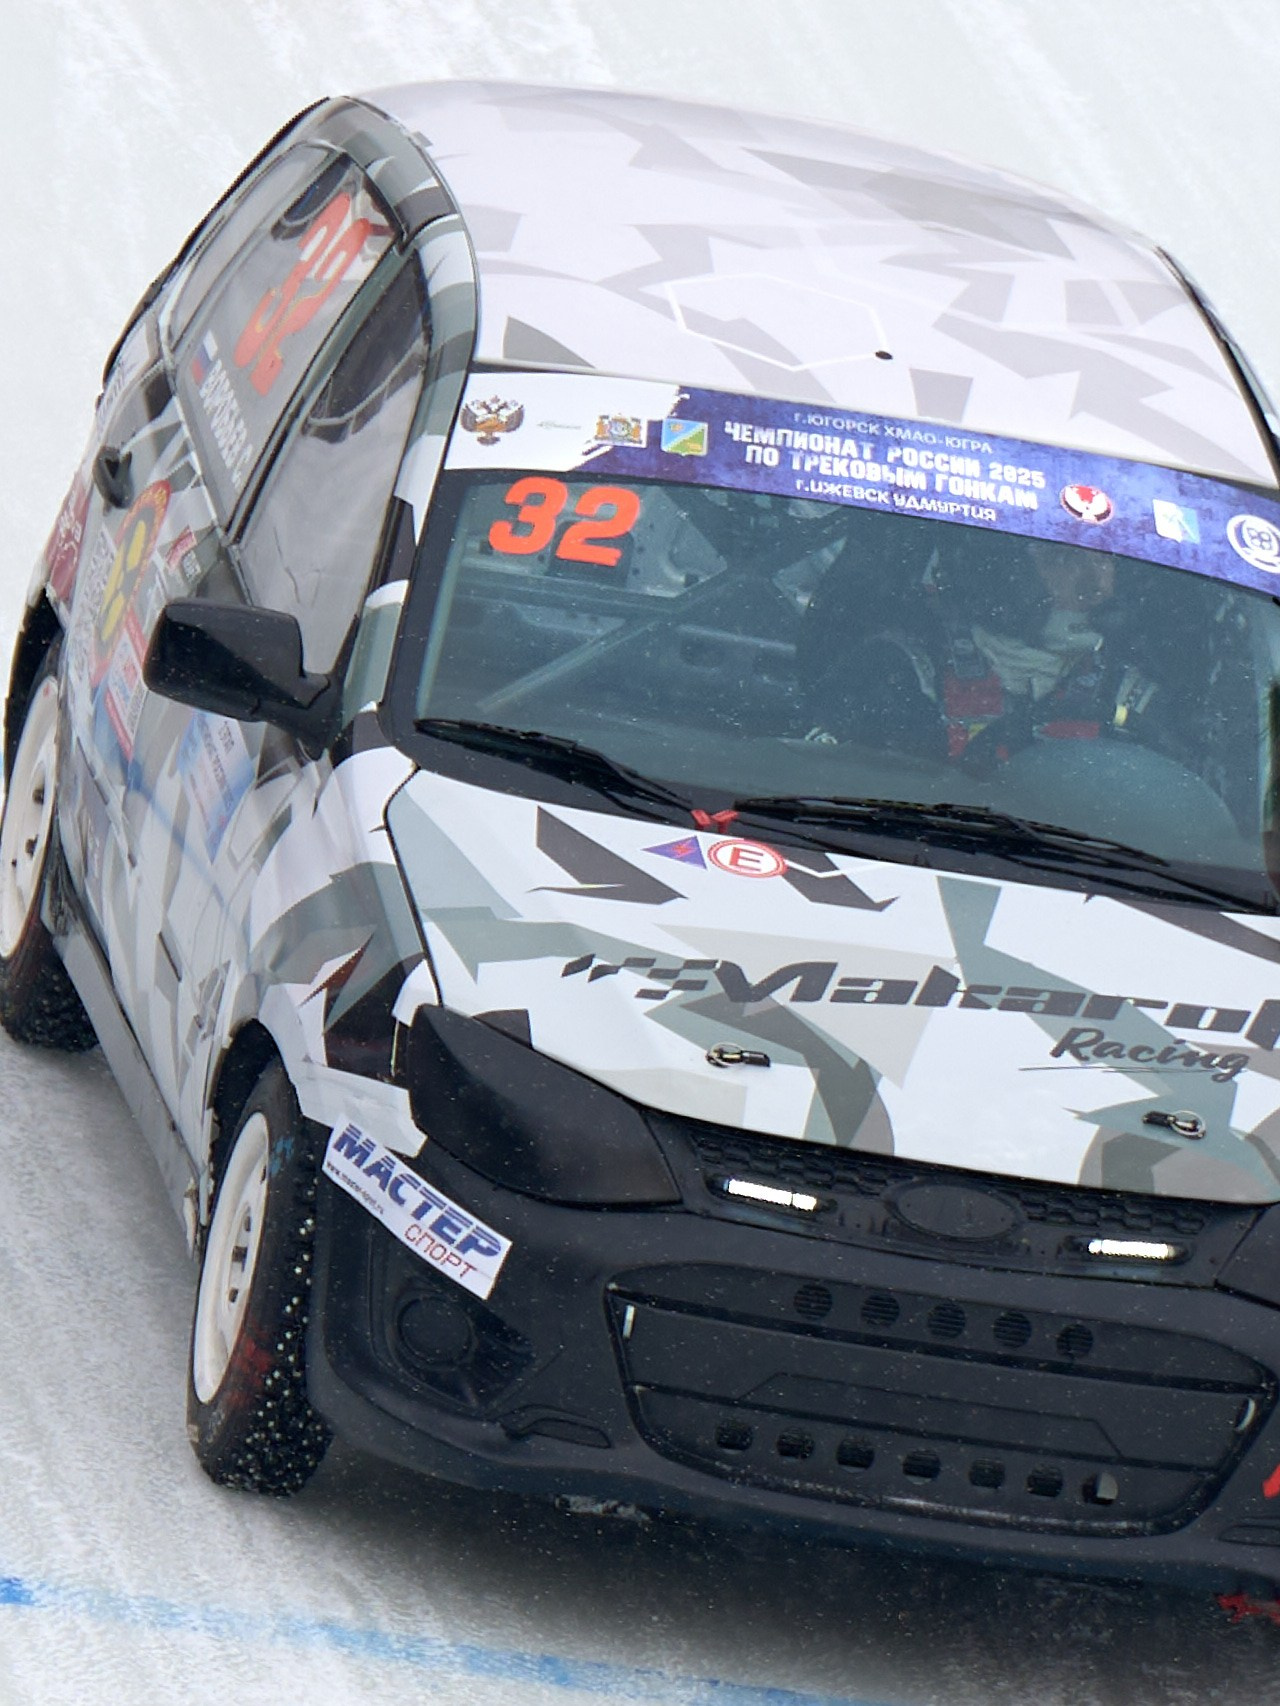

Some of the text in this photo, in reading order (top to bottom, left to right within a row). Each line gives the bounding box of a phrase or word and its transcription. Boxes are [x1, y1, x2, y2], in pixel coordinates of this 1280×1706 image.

[724, 420, 1047, 489] ЧЕМПИОНАТ РОССИИ 2025
[744, 444, 1039, 510] ПО ТРЕКОВЫМ ГОНКАМ
[488, 476, 641, 567] 32
[892, 492, 996, 521] УДМУРТИЯ
[729, 846, 762, 871] E
[1049, 1026, 1250, 1083] Racing
[332, 1122, 502, 1258] МАСТЕР
[404, 1223, 478, 1279] СПОРТ
